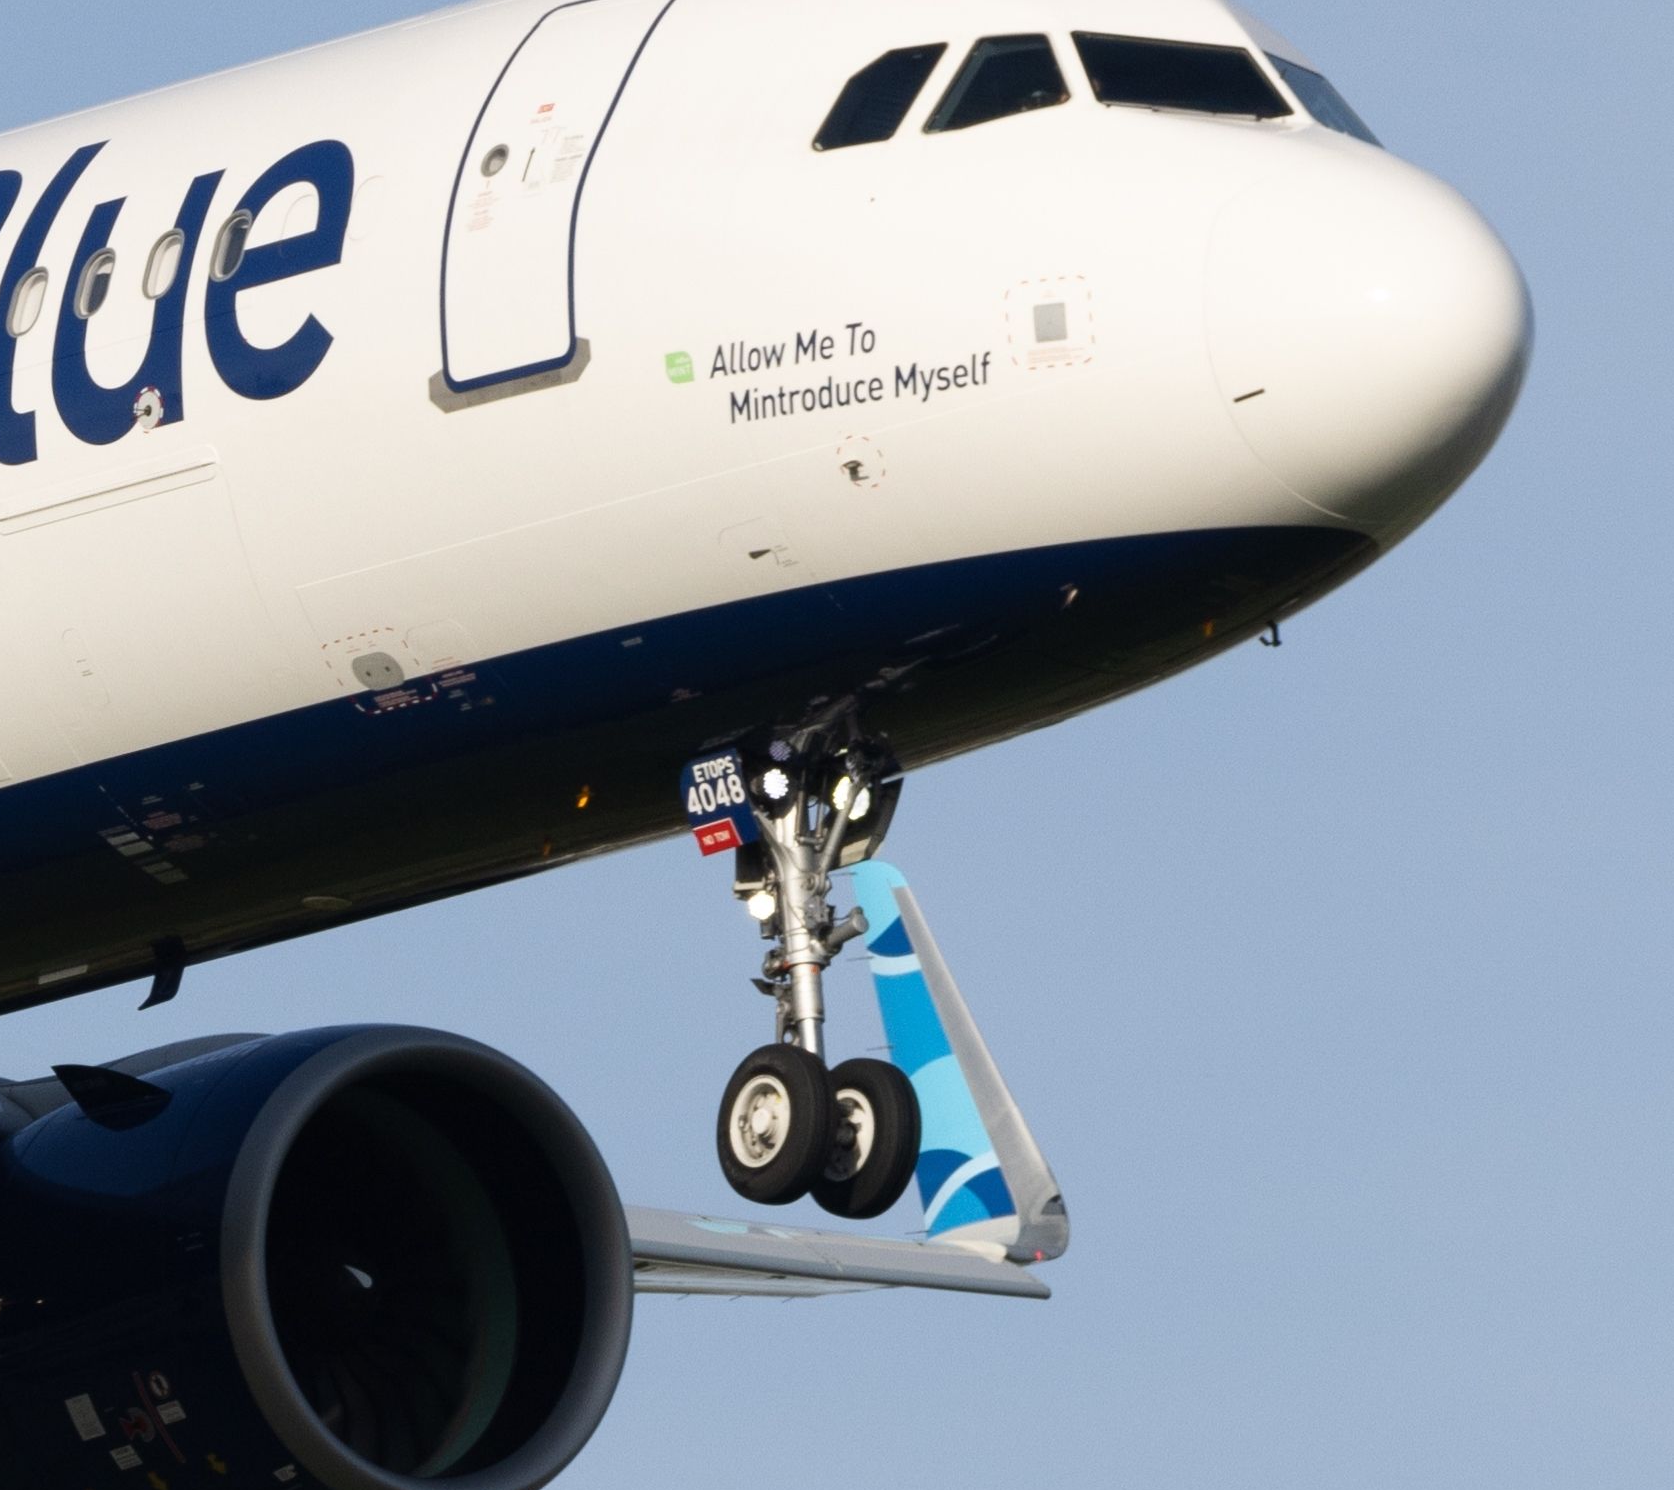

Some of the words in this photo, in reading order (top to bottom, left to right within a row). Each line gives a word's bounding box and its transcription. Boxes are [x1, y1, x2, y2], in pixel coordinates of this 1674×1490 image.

[710, 341, 786, 379] Allow
[794, 329, 835, 365] Me
[845, 322, 876, 356] To
[729, 376, 884, 424] Mintroduce
[894, 351, 992, 403] Myself
[693, 756, 735, 782] ETOPS
[688, 775, 745, 815] 4048
